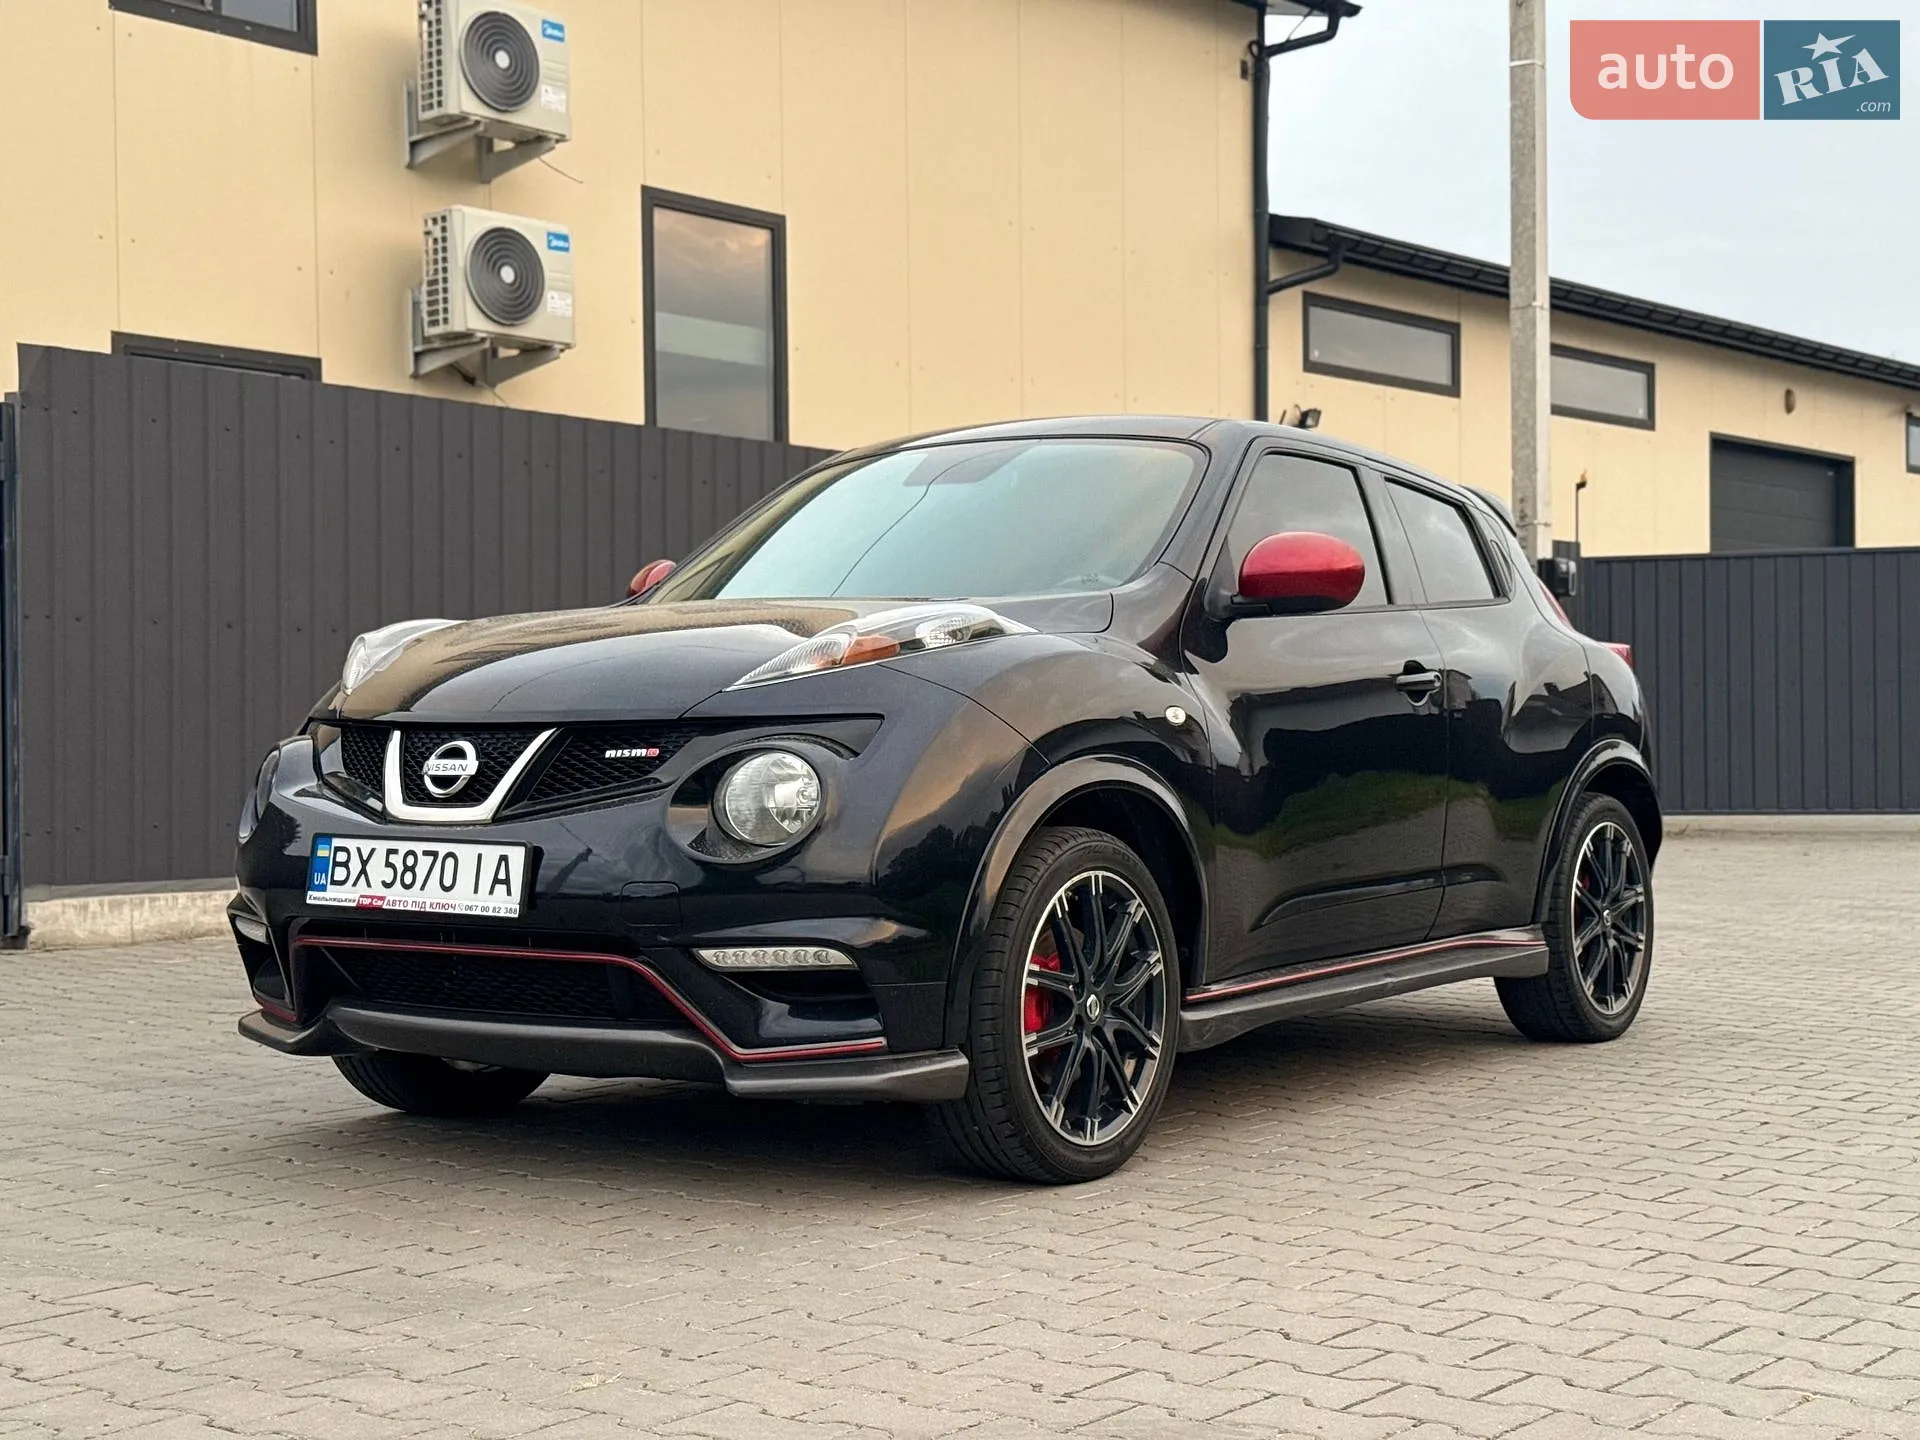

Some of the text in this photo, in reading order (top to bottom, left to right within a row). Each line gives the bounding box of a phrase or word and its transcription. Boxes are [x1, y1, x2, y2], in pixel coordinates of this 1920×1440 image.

[424, 762, 468, 773] NISSAN
[329, 846, 512, 897] BX 5870 IA
[314, 872, 327, 886] UA
[386, 899, 457, 911] АВТО ПІД КЛЮЧ
[465, 904, 478, 912] 067
[480, 905, 490, 913] 00
